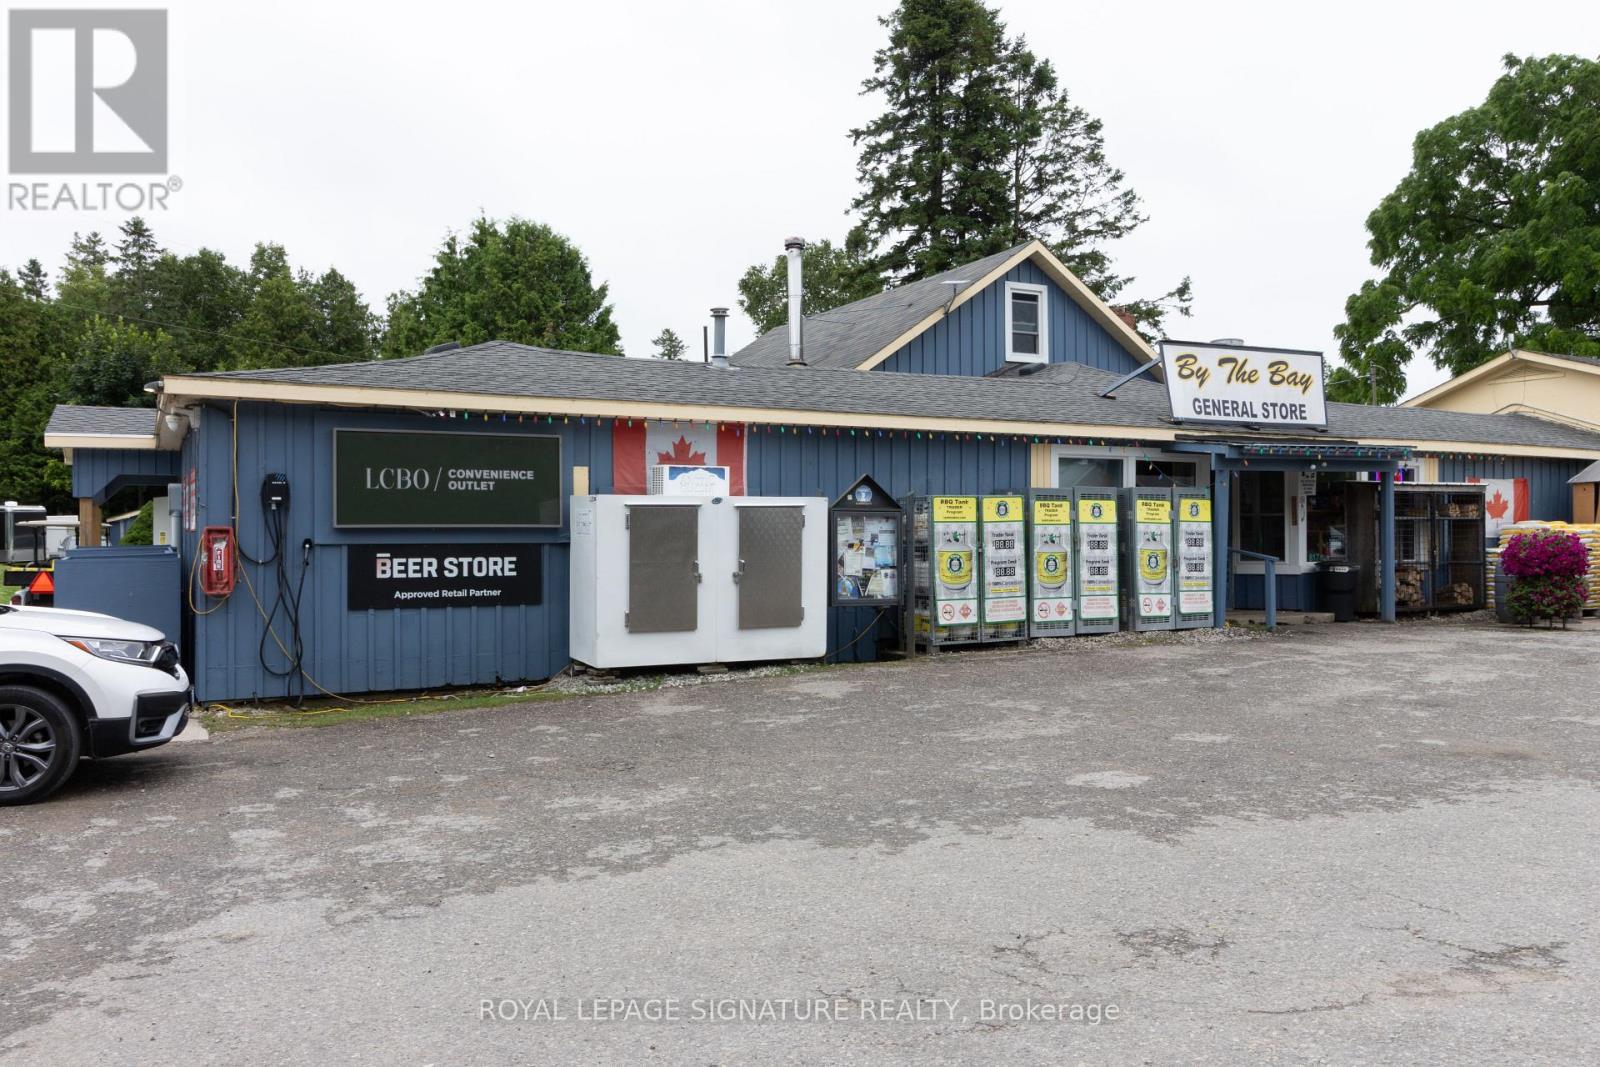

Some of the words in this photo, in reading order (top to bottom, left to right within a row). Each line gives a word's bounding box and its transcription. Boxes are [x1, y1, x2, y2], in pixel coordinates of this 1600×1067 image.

[1175, 353, 1211, 389] By
[1217, 356, 1260, 386] The
[1267, 360, 1314, 396] Bay
[1192, 397, 1258, 419] GENERAL
[1261, 402, 1308, 421] STORE
[447, 468, 535, 480] CONVENIENCE
[447, 480, 496, 491] OUTLET
[375, 552, 438, 579] BEER
[443, 556, 518, 578] STORE
[393, 589, 440, 600] Approved
[441, 588, 467, 598] Retail
[469, 588, 502, 598] Partner
